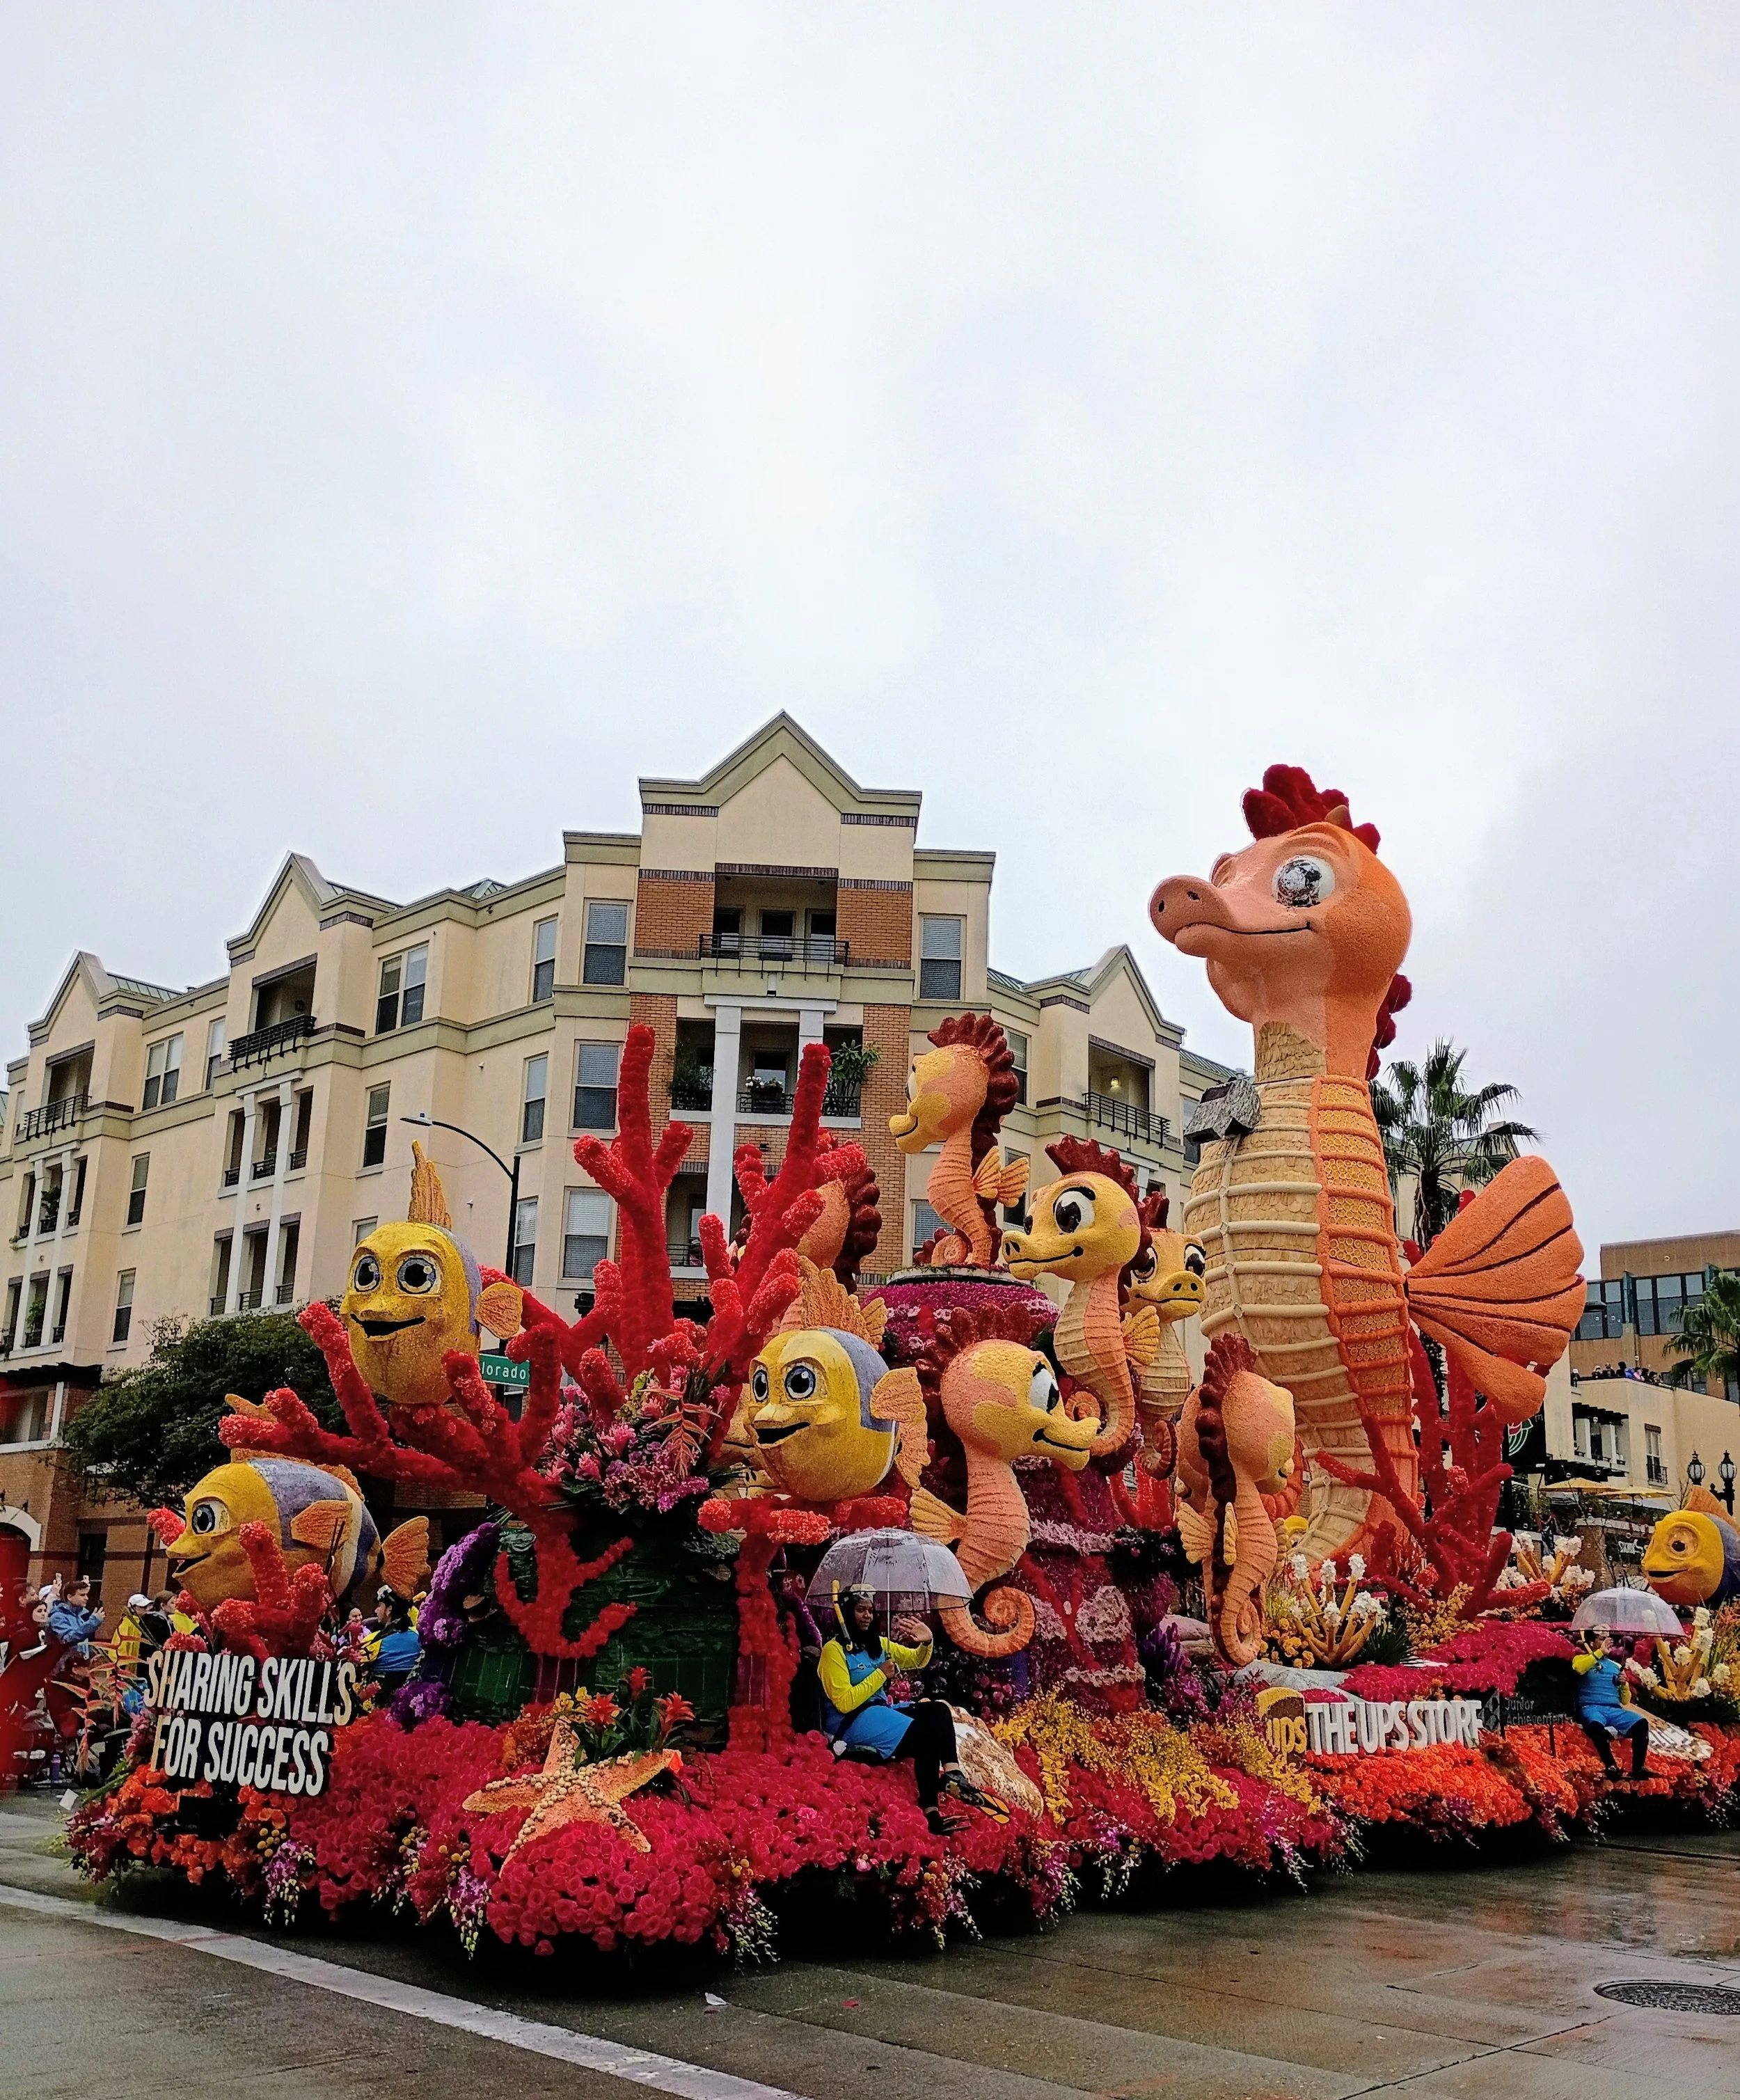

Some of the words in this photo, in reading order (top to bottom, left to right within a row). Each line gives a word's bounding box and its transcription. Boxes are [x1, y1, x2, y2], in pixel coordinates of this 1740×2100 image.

[482, 1361, 526, 1380] lorado
[144, 1650, 255, 1715] SHARING
[257, 1657, 356, 1726] SKILLS
[1504, 1696, 1535, 1711] Junior
[150, 1714, 202, 1779] FOR
[204, 1721, 329, 1796] SUCCESS
[1305, 1702, 1359, 1755] THE
[1355, 1701, 1409, 1754] UPS
[1407, 1700, 1483, 1751] STORE
